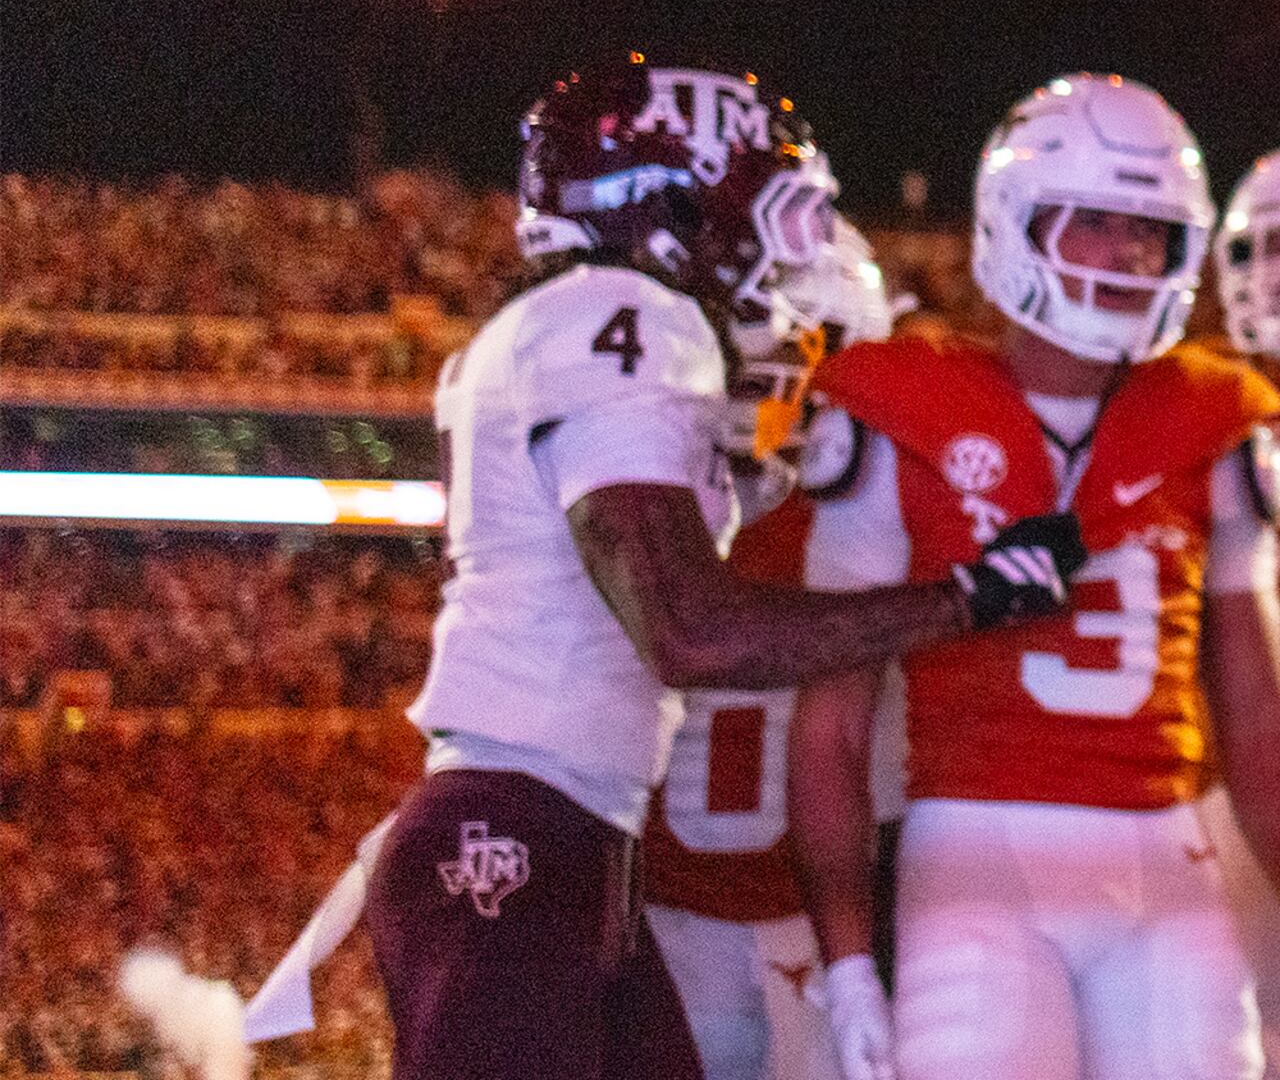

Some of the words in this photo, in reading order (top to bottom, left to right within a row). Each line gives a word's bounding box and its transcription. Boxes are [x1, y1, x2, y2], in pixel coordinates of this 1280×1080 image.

[633, 68, 771, 186] ATM
[592, 307, 645, 376] 4
[1020, 544, 1160, 720] 3
[664, 687, 797, 854] 0
